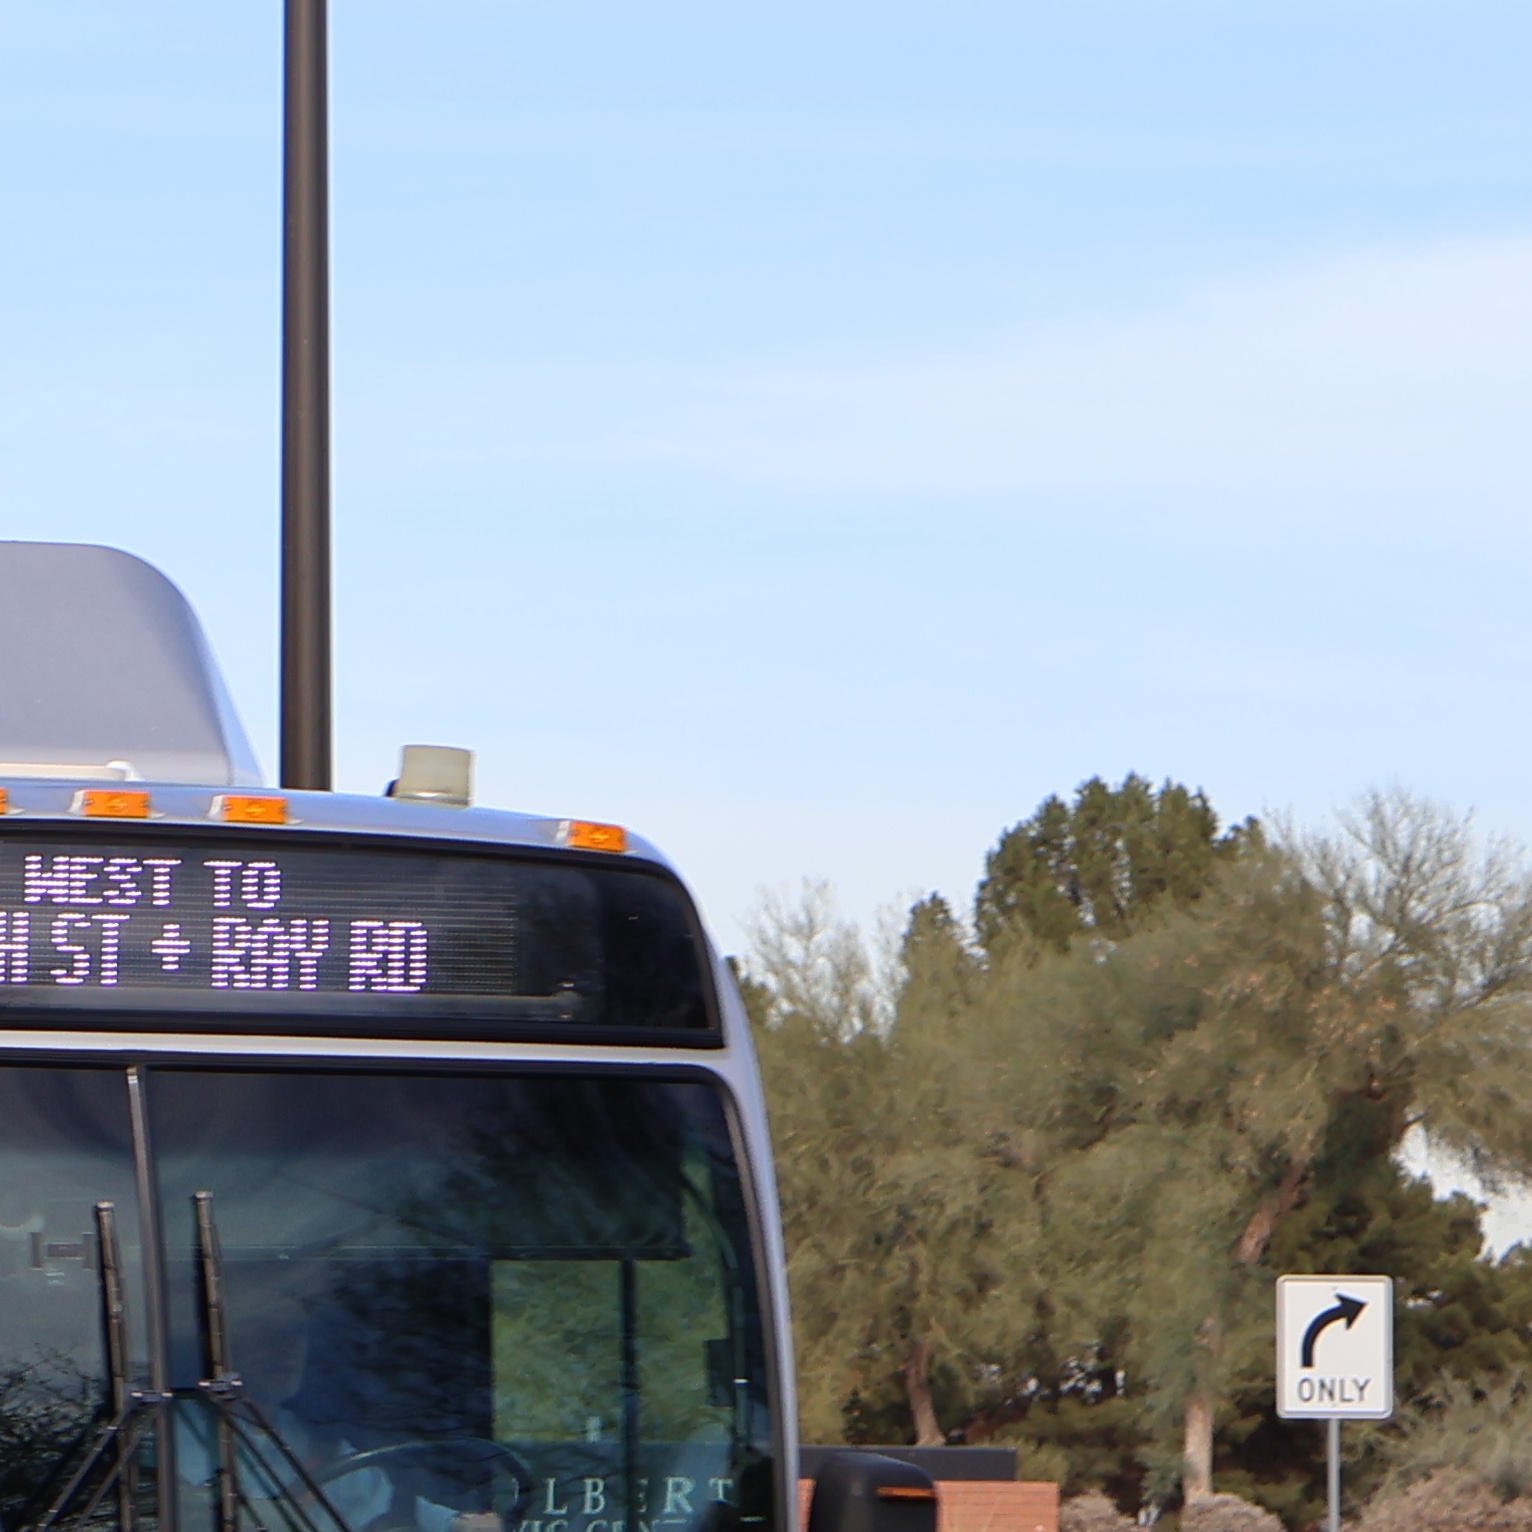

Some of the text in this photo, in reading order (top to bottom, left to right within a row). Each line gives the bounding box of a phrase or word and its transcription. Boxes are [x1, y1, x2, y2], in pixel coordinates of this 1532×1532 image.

[24, 855, 282, 908] WEST TO
[49, 912, 131, 986] ST
[151, 923, 191, 970] +
[210, 916, 331, 991] RAY
[347, 920, 428, 992] RD
[1297, 1376, 1373, 1403] ONLY
